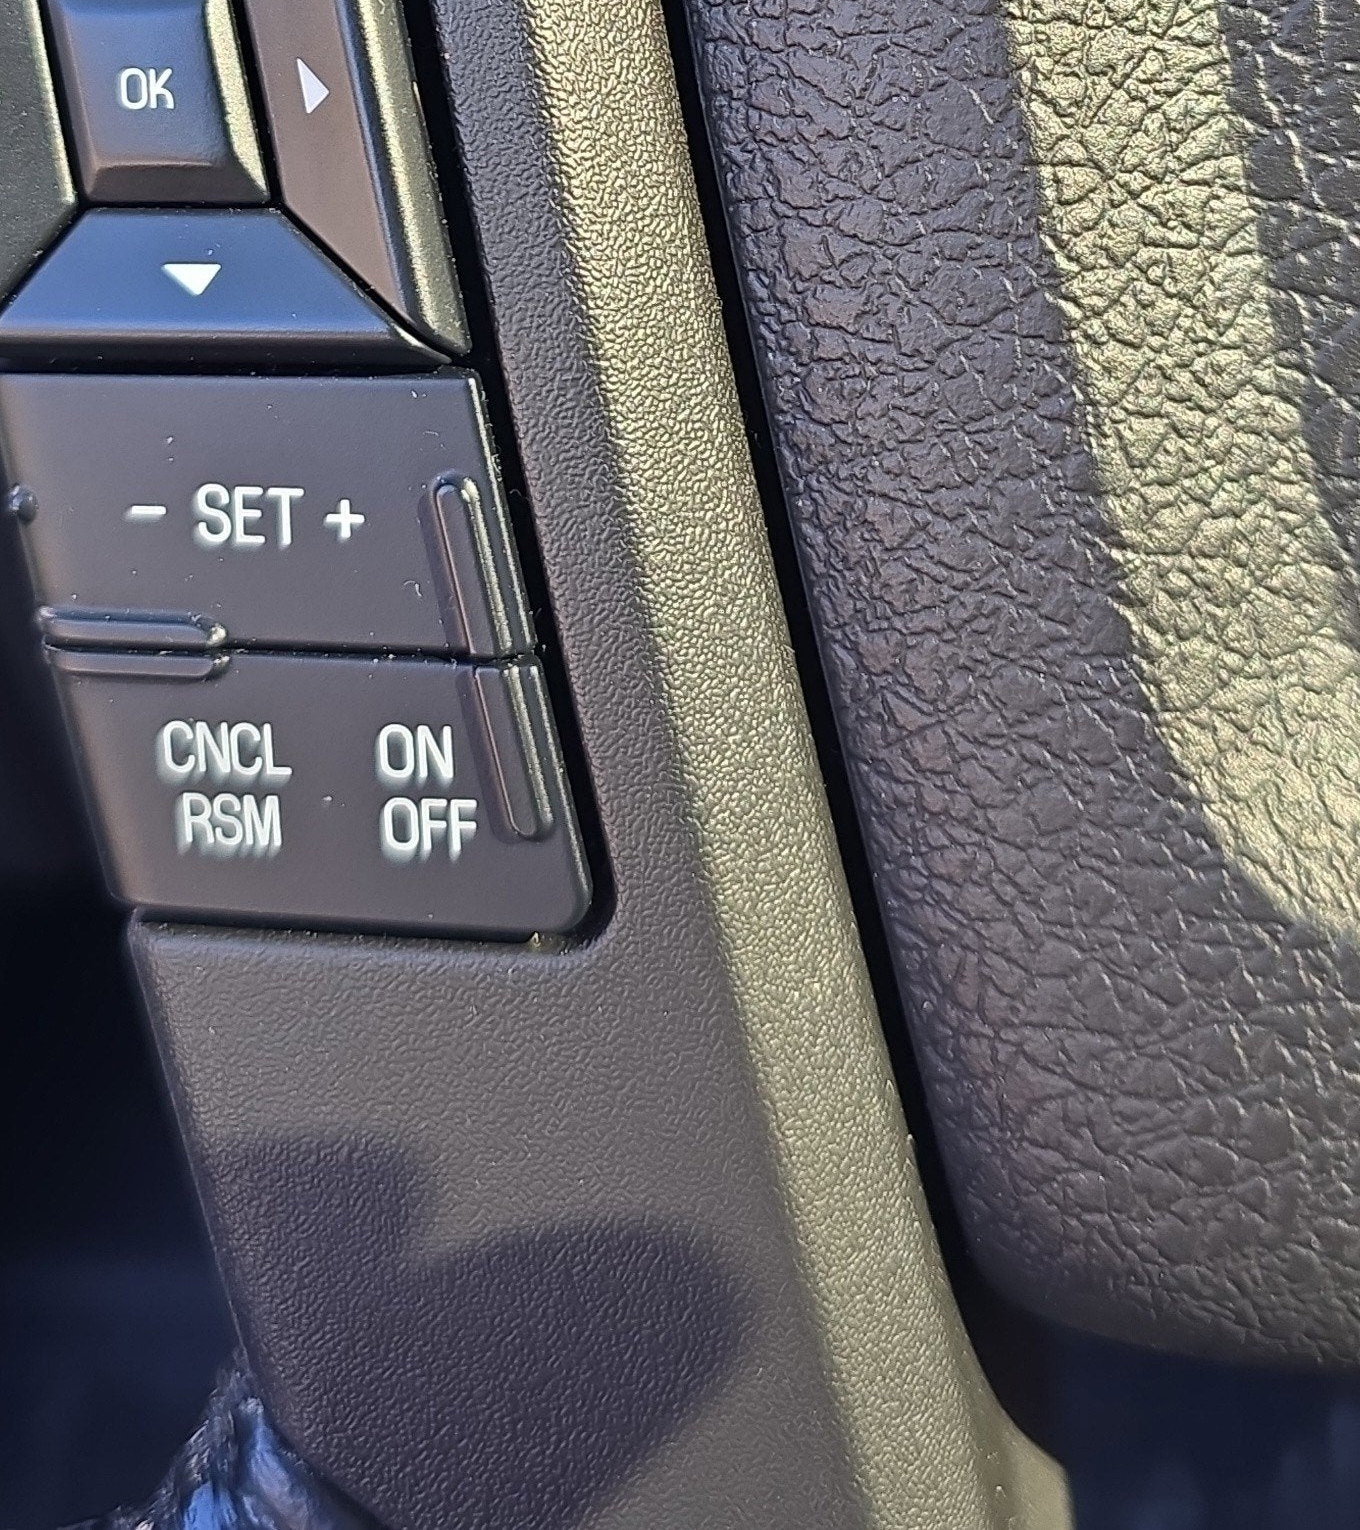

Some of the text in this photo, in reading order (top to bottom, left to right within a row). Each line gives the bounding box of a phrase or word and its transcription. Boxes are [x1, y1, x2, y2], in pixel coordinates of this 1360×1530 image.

[119, 66, 176, 111] OK
[194, 483, 305, 548] SET
[158, 719, 293, 783] CNCL
[374, 723, 455, 785] ON
[176, 792, 284, 857] RSM
[381, 797, 478, 862] OFF
